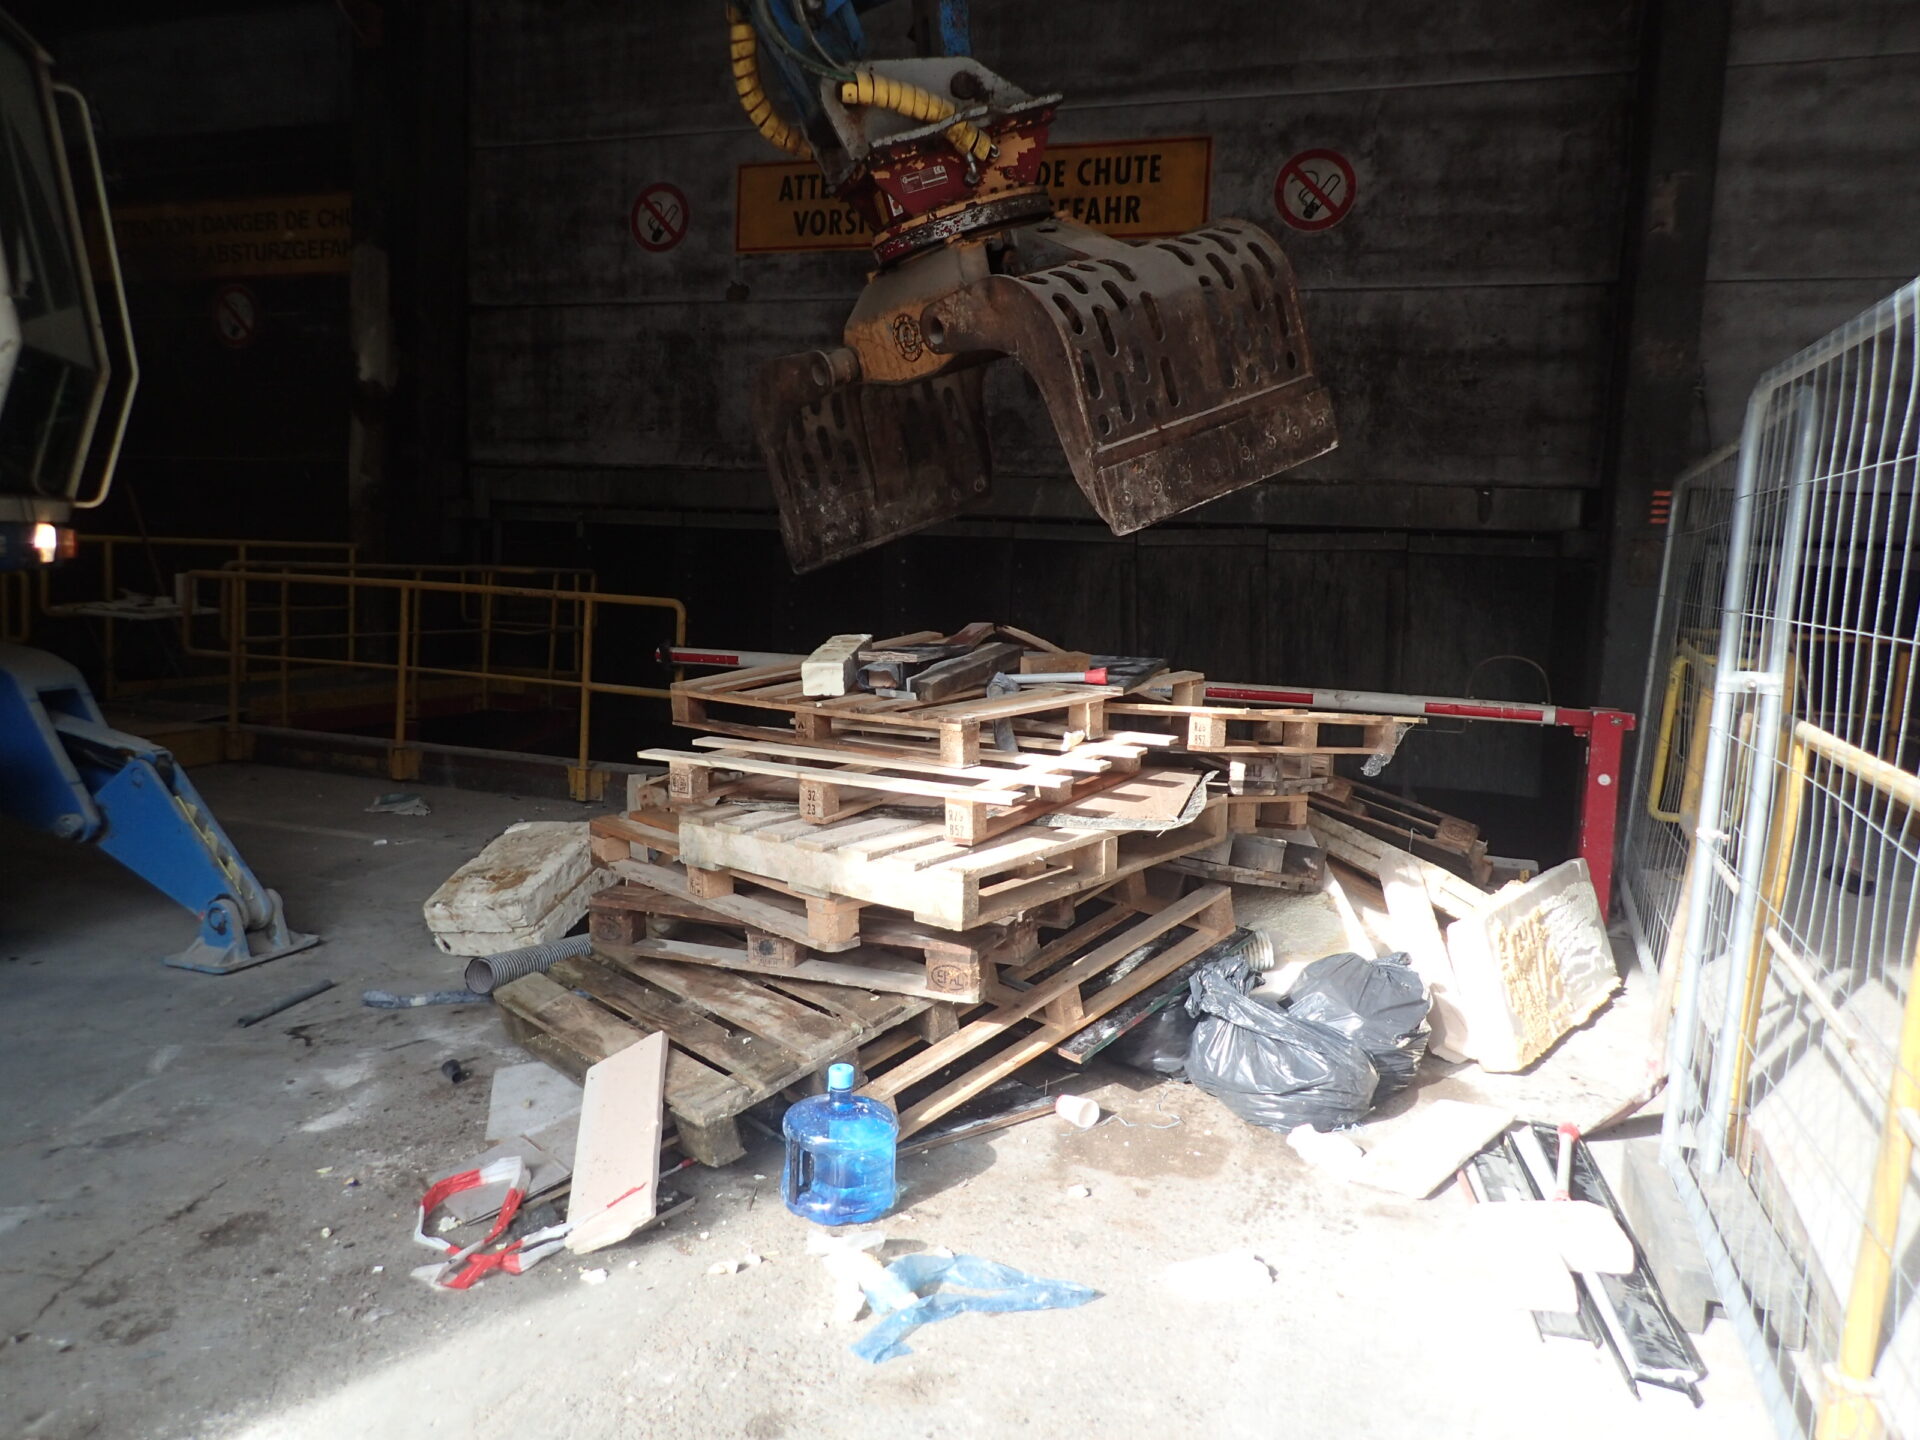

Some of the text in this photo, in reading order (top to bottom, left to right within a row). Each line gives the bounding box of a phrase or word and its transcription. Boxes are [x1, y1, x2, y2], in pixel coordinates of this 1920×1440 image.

[1035, 154, 1162, 187] DE CHUTE
[202, 210, 278, 234] DANGER
[287, 209, 311, 230] DE
[807, 790, 816, 801] 32
[807, 803, 816, 815] 23
